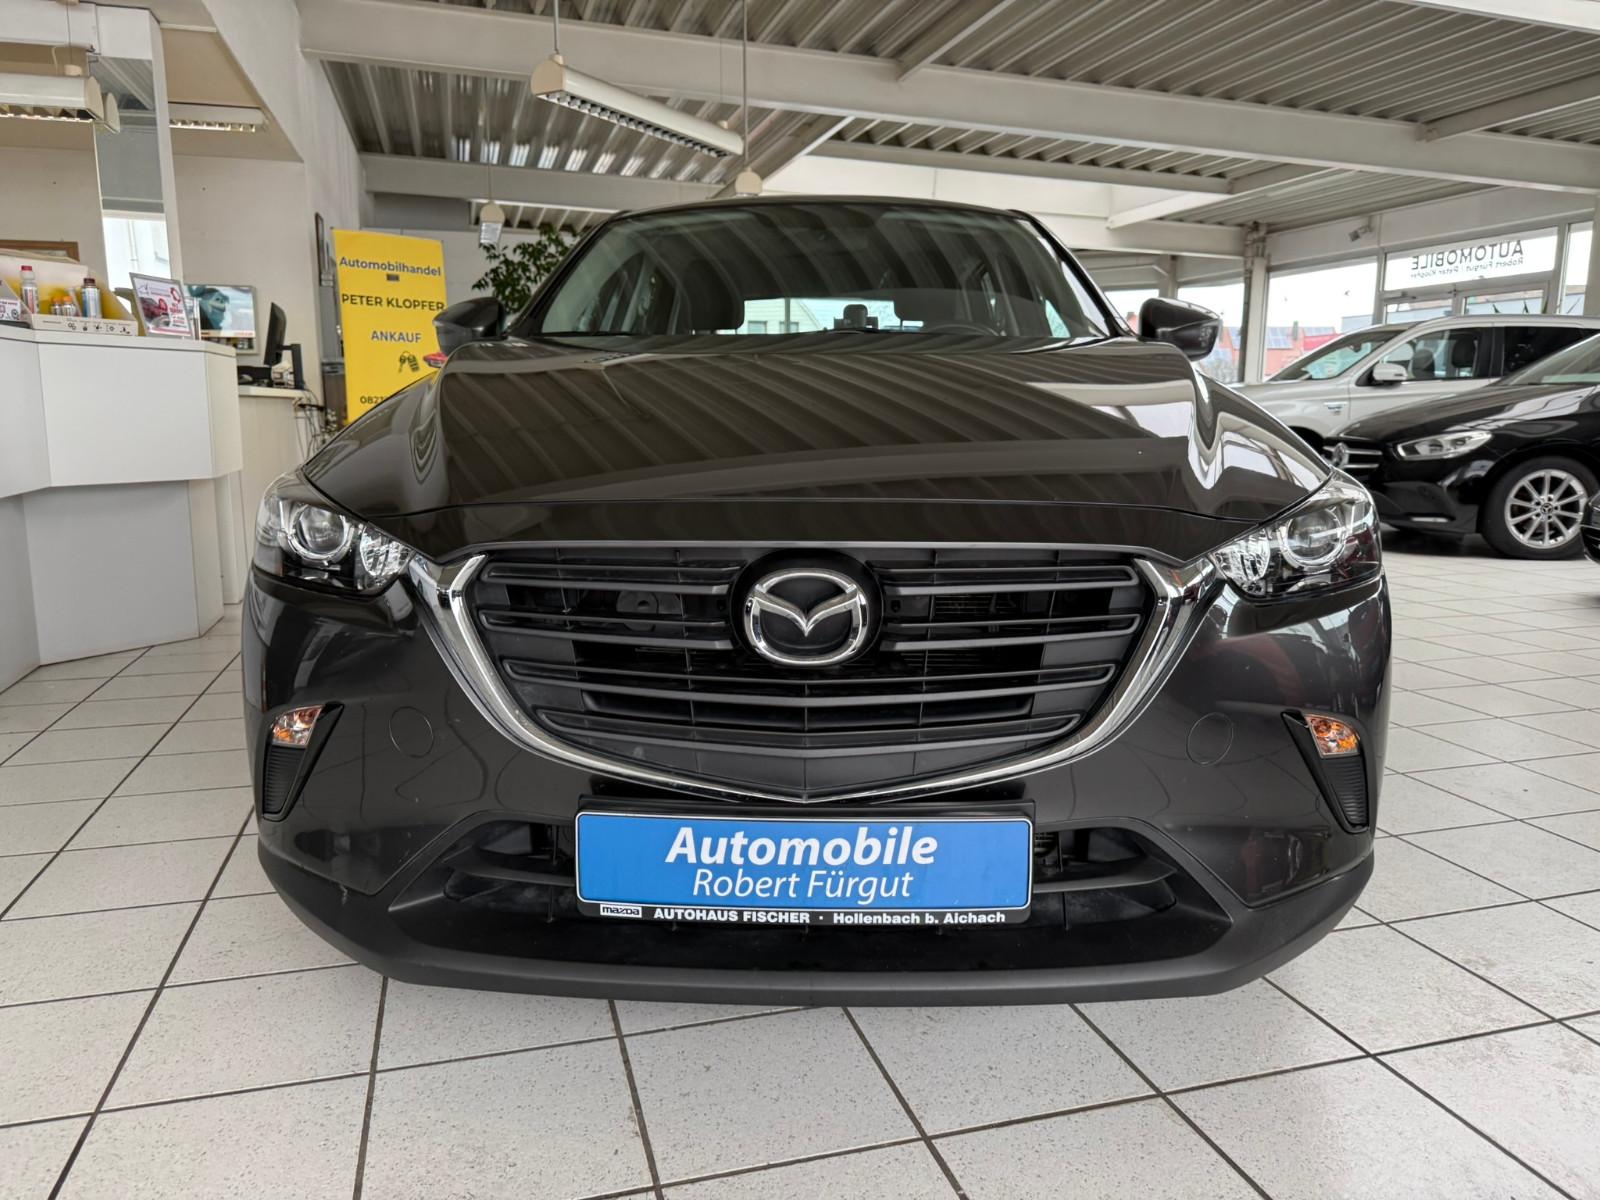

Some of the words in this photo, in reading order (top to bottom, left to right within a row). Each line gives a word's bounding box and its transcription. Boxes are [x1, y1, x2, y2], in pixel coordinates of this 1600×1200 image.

[339, 256, 441, 277] Automobilhandel
[341, 293, 383, 307] PETER
[386, 297, 445, 312] KLOPFER
[371, 330, 422, 343] ANKAUF
[665, 826, 938, 866] Automobile
[693, 868, 800, 898] Robert
[807, 869, 914, 906] Fürgut
[653, 908, 738, 922] AUTOHAUS
[743, 911, 810, 924] FISCHER
[833, 912, 920, 925] Hollenbach
[925, 912, 939, 924] b.
[943, 912, 1006, 924] Aichach
